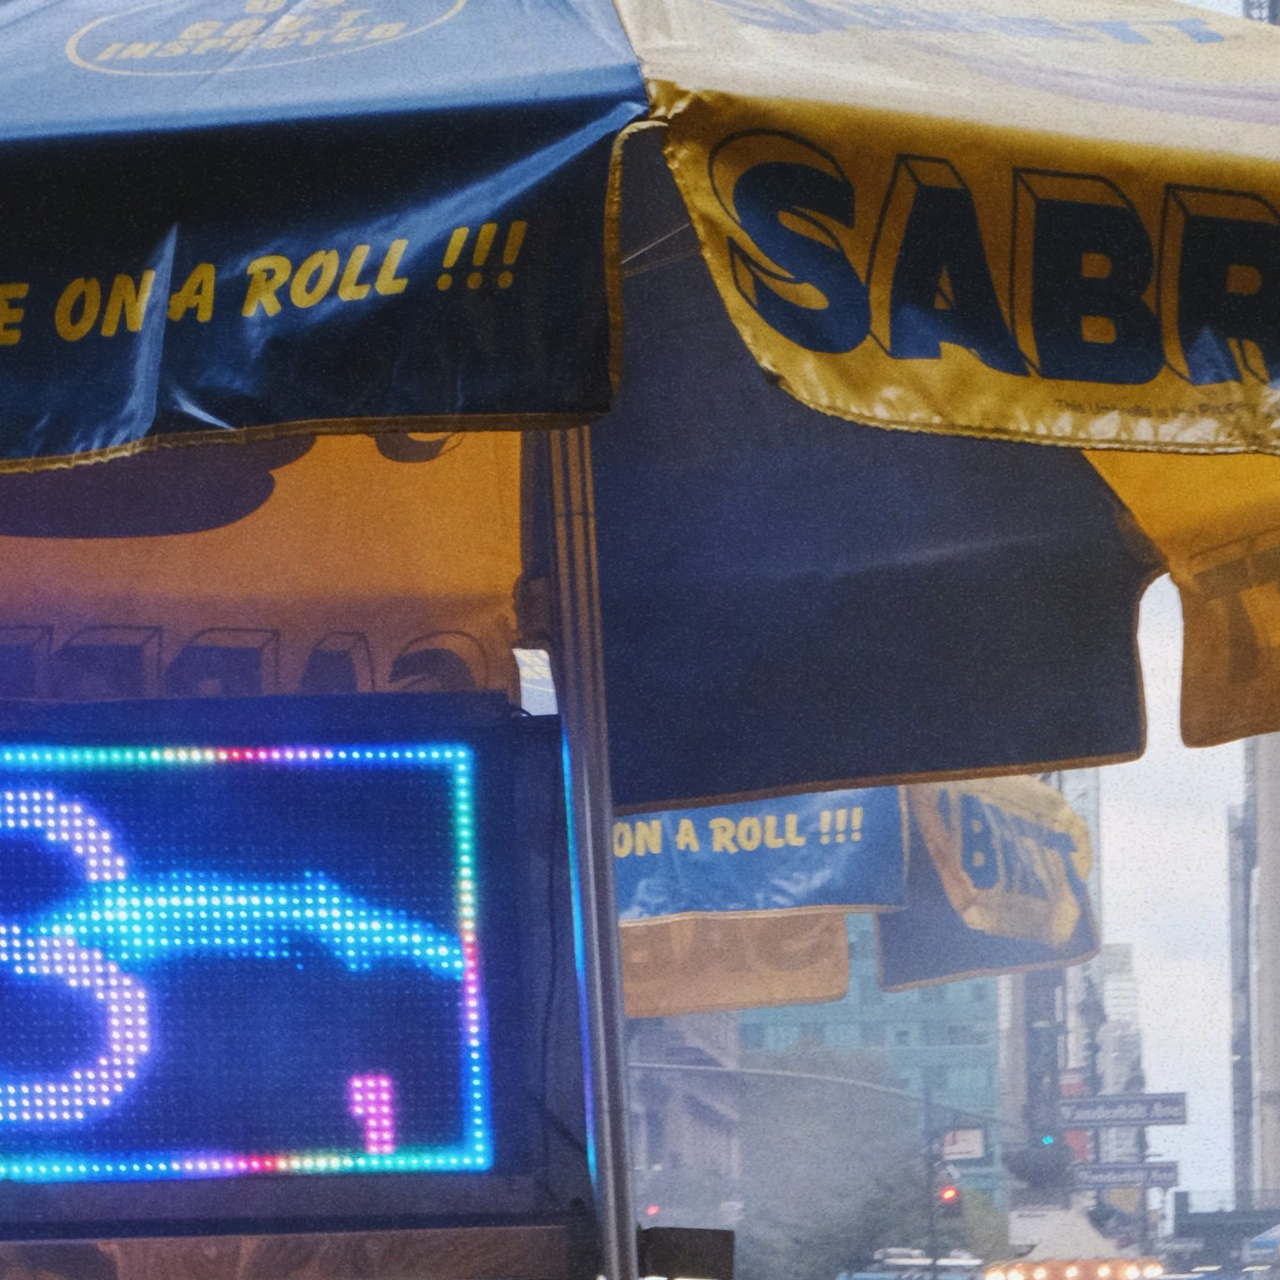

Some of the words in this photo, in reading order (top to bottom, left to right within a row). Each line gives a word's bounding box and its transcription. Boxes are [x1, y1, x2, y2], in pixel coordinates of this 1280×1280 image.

[54, 269, 155, 342] ON
[168, 263, 216, 322] A
[242, 239, 410, 318] ROLL
[437, 220, 528, 291] !!!
[613, 820, 662, 857] ON
[676, 818, 700, 852] A
[709, 813, 806, 854] ROLL
[819, 807, 864, 845] !!!
